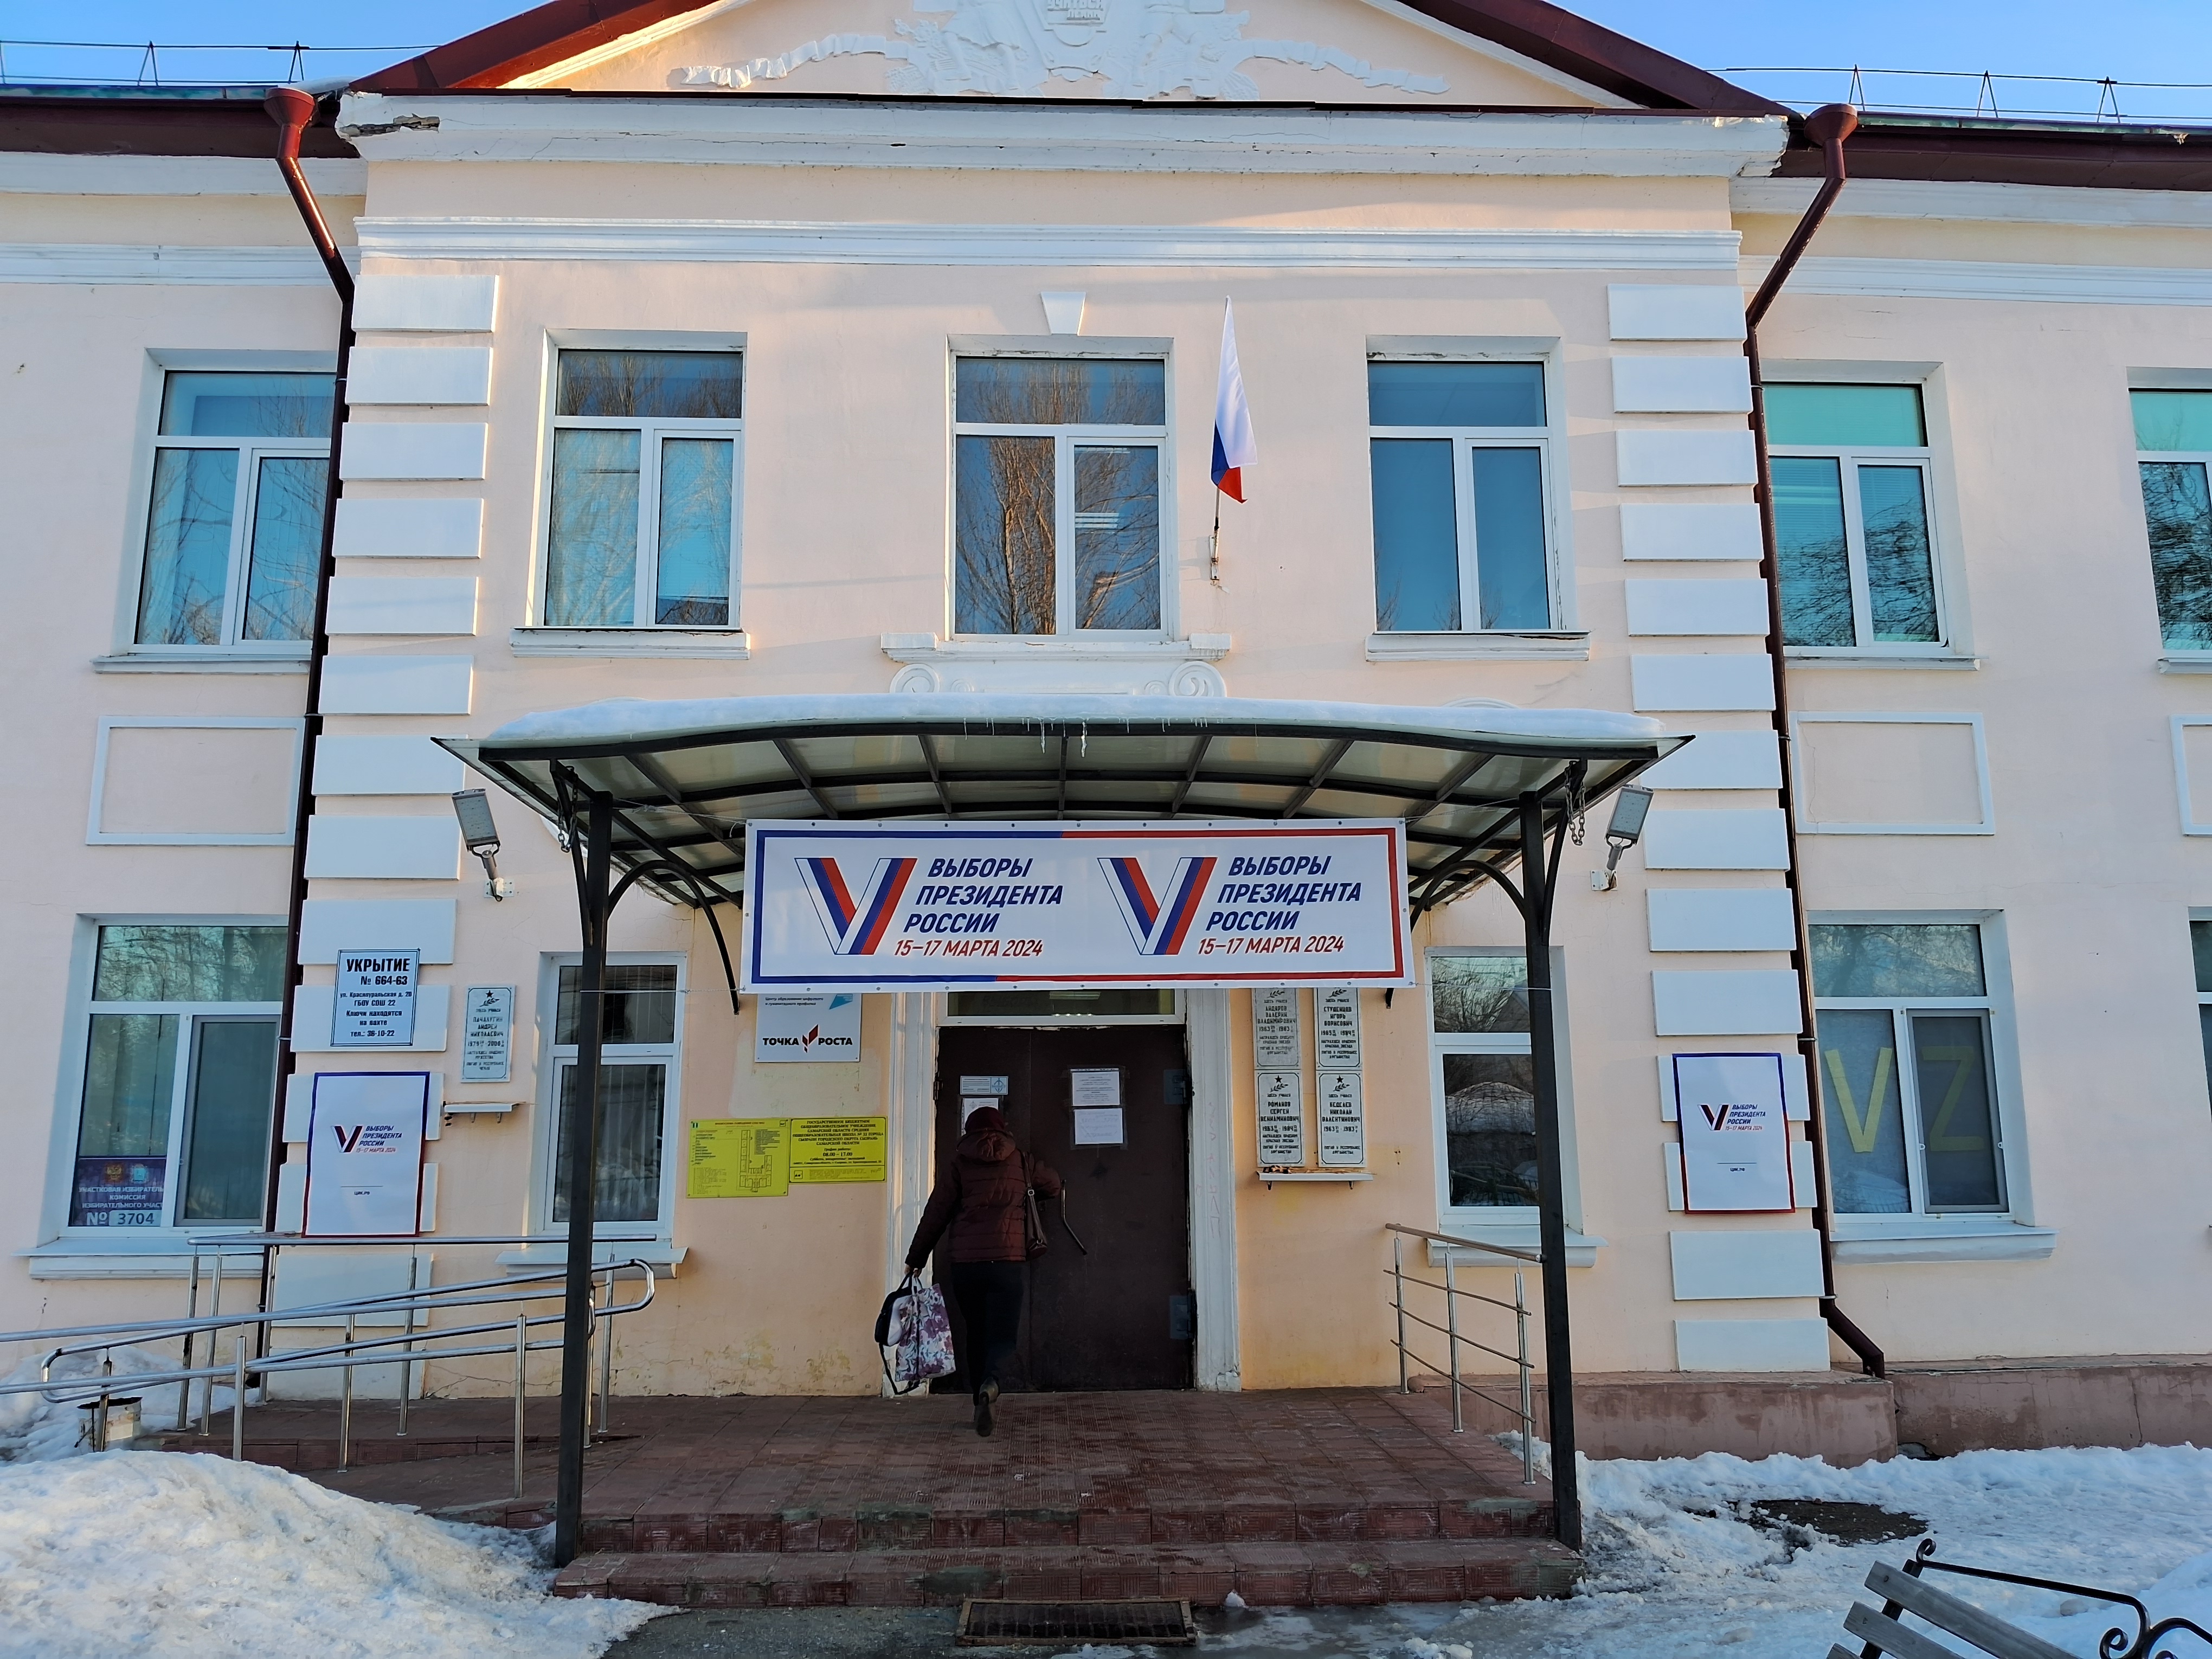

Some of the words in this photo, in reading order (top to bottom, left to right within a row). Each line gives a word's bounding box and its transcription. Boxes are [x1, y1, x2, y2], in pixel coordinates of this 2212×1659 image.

[927, 858, 1033, 878] ВЫБОРЫ
[1228, 856, 1332, 876] ВЫБОРЫ
[915, 885, 1063, 908] ПРЕЗИДЕНТА
[1217, 882, 1361, 905] ПРЕЗИДЕНТА
[903, 913, 1000, 933] РОССИИ
[1206, 911, 1300, 931] РОССИИ
[944, 940, 999, 957] МАРТА
[1002, 940, 1043, 957] 2024
[1245, 937, 1301, 954] МАРТА
[1304, 936, 1344, 953] 2024
[347, 959, 410, 972] УКРЫТИЕ
[361, 976, 371, 985] №
[375, 976, 408, 985] 664-63
[86, 1212, 107, 1226] №
[118, 1213, 155, 1225] 3704
